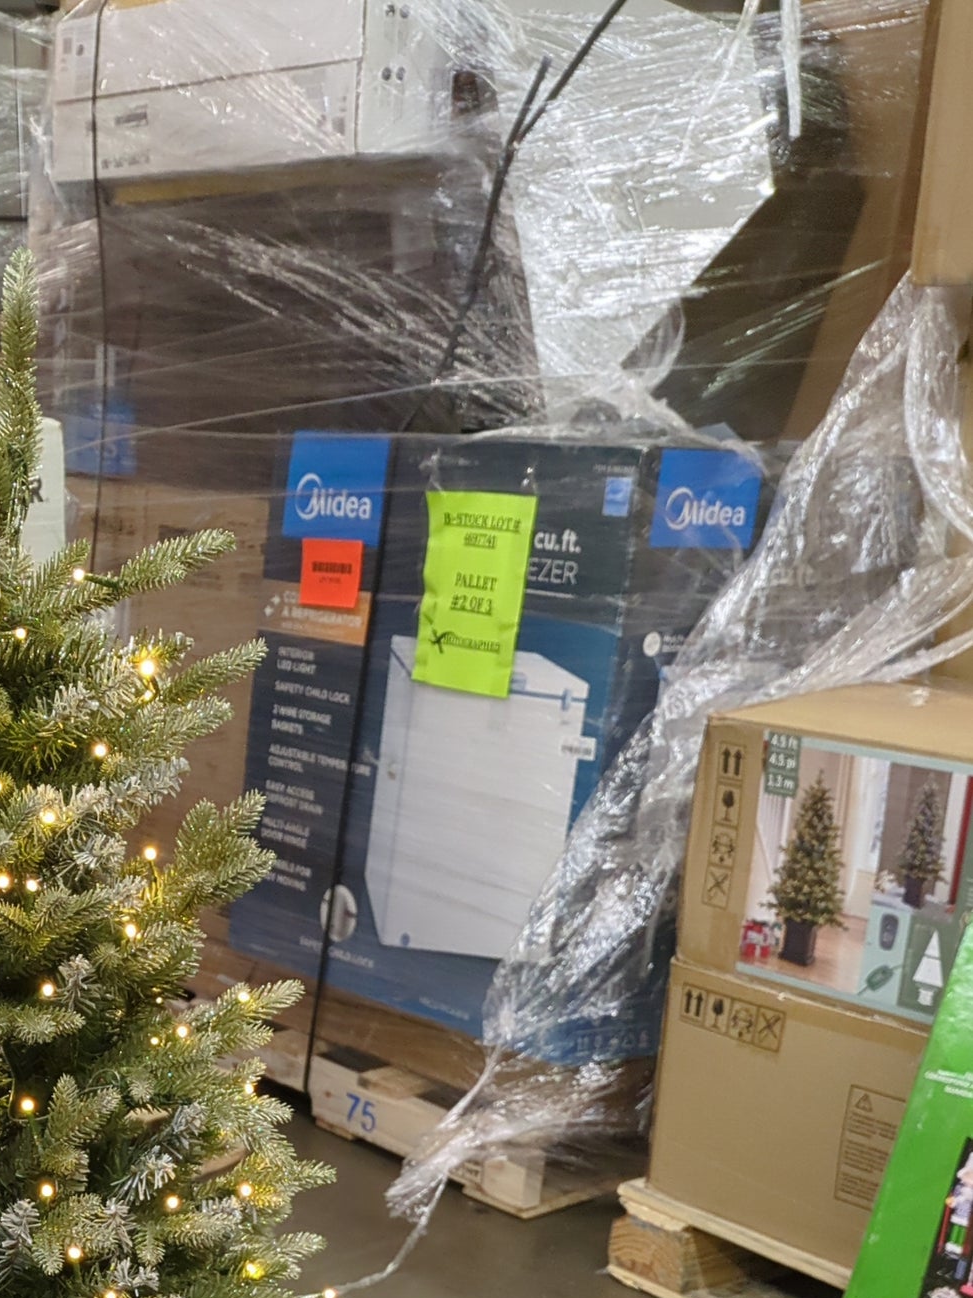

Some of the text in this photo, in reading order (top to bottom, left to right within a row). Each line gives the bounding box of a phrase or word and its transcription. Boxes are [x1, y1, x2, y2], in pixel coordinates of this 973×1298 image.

[295, 473, 372, 520] Midea
[665, 486, 745, 530] Midea
[490, 515, 513, 531] LOT
[534, 529, 581, 554] cu.ft.
[454, 572, 498, 592] PALLET
[274, 680, 351, 705] SAFETY CHILD LOCK
[346, 1092, 376, 1134] 75
